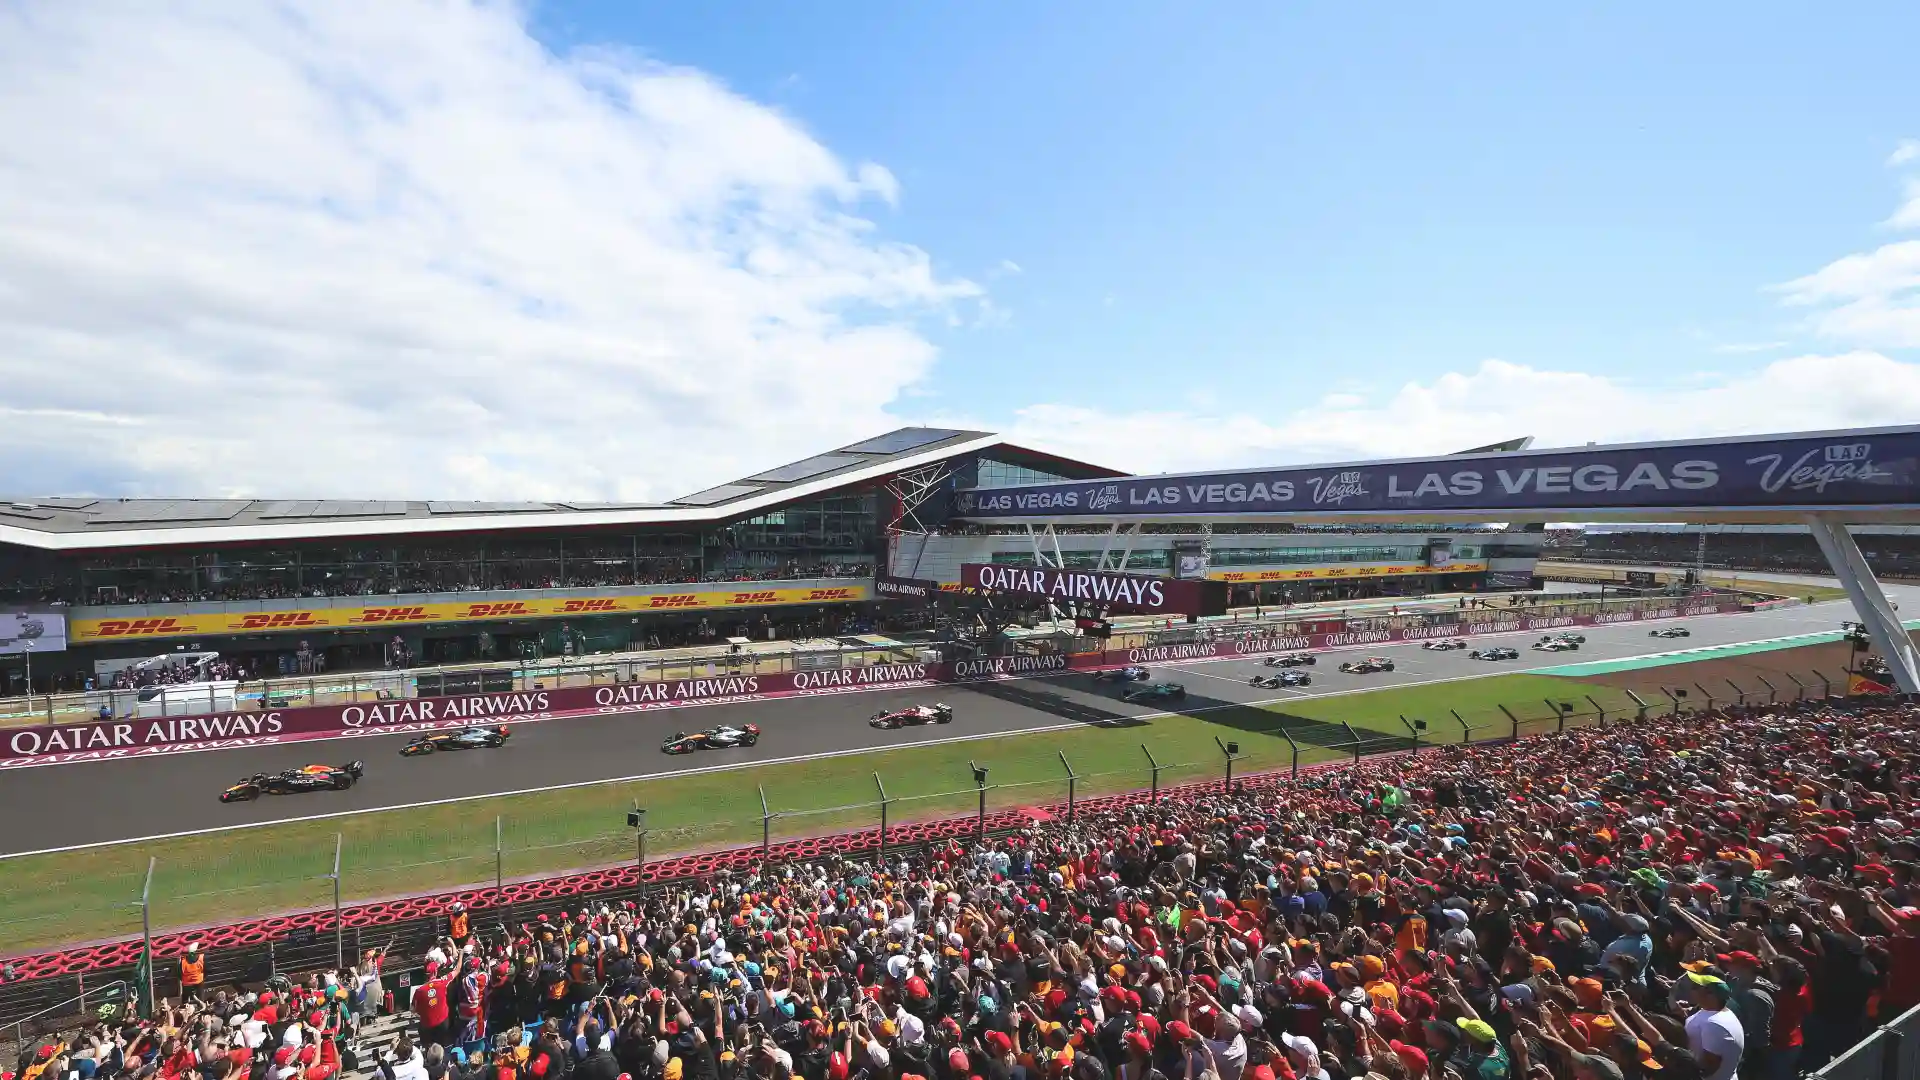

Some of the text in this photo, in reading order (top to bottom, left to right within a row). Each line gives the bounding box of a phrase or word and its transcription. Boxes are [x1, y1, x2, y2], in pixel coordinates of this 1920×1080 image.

[1828, 445, 1867, 460] LAS
[1387, 460, 1719, 499] LAS VEGAS
[1746, 448, 1893, 493] Vegas
[1130, 481, 1295, 505] LAS VEGAS
[1306, 474, 1369, 504] Vegas
[978, 496, 1012, 510] LAS
[1015, 492, 1079, 509] VEGAS
[1085, 488, 1122, 510] Vegas
[809, 588, 855, 600] DHL
[877, 581, 898, 593] QATAR
[899, 584, 926, 597] AIRWAYS
[979, 566, 1164, 606] QATAR AIRWAYS
[563, 599, 617, 612] DHL
[650, 595, 698, 608] DHL
[734, 591, 777, 604] DHL
[361, 607, 430, 622] DHL
[467, 603, 531, 617] DHL
[97, 618, 183, 636] DHL
[240, 612, 314, 629] DHL
[1469, 621, 1520, 635] QATAR AIRWAYS
[1326, 630, 1390, 646] QATAR AIRWAYS
[1402, 625, 1459, 640] QATAR AIRWAYS
[1129, 643, 1216, 662] QATAR AIRWAYS
[1236, 636, 1309, 654] QATAR AIRWAYS
[955, 654, 1065, 676] QATAR AIRWAYS
[794, 663, 925, 690] QATAR AIRWAYS
[595, 676, 759, 706] QATAR AIRWAYS
[341, 692, 549, 728] QATAR AIRWAYS
[341, 711, 552, 736] QATAR AIRWAYS
[10, 712, 283, 755] QATAR AIRWAYS
[0, 736, 281, 767] QATAR AIRWAYS
